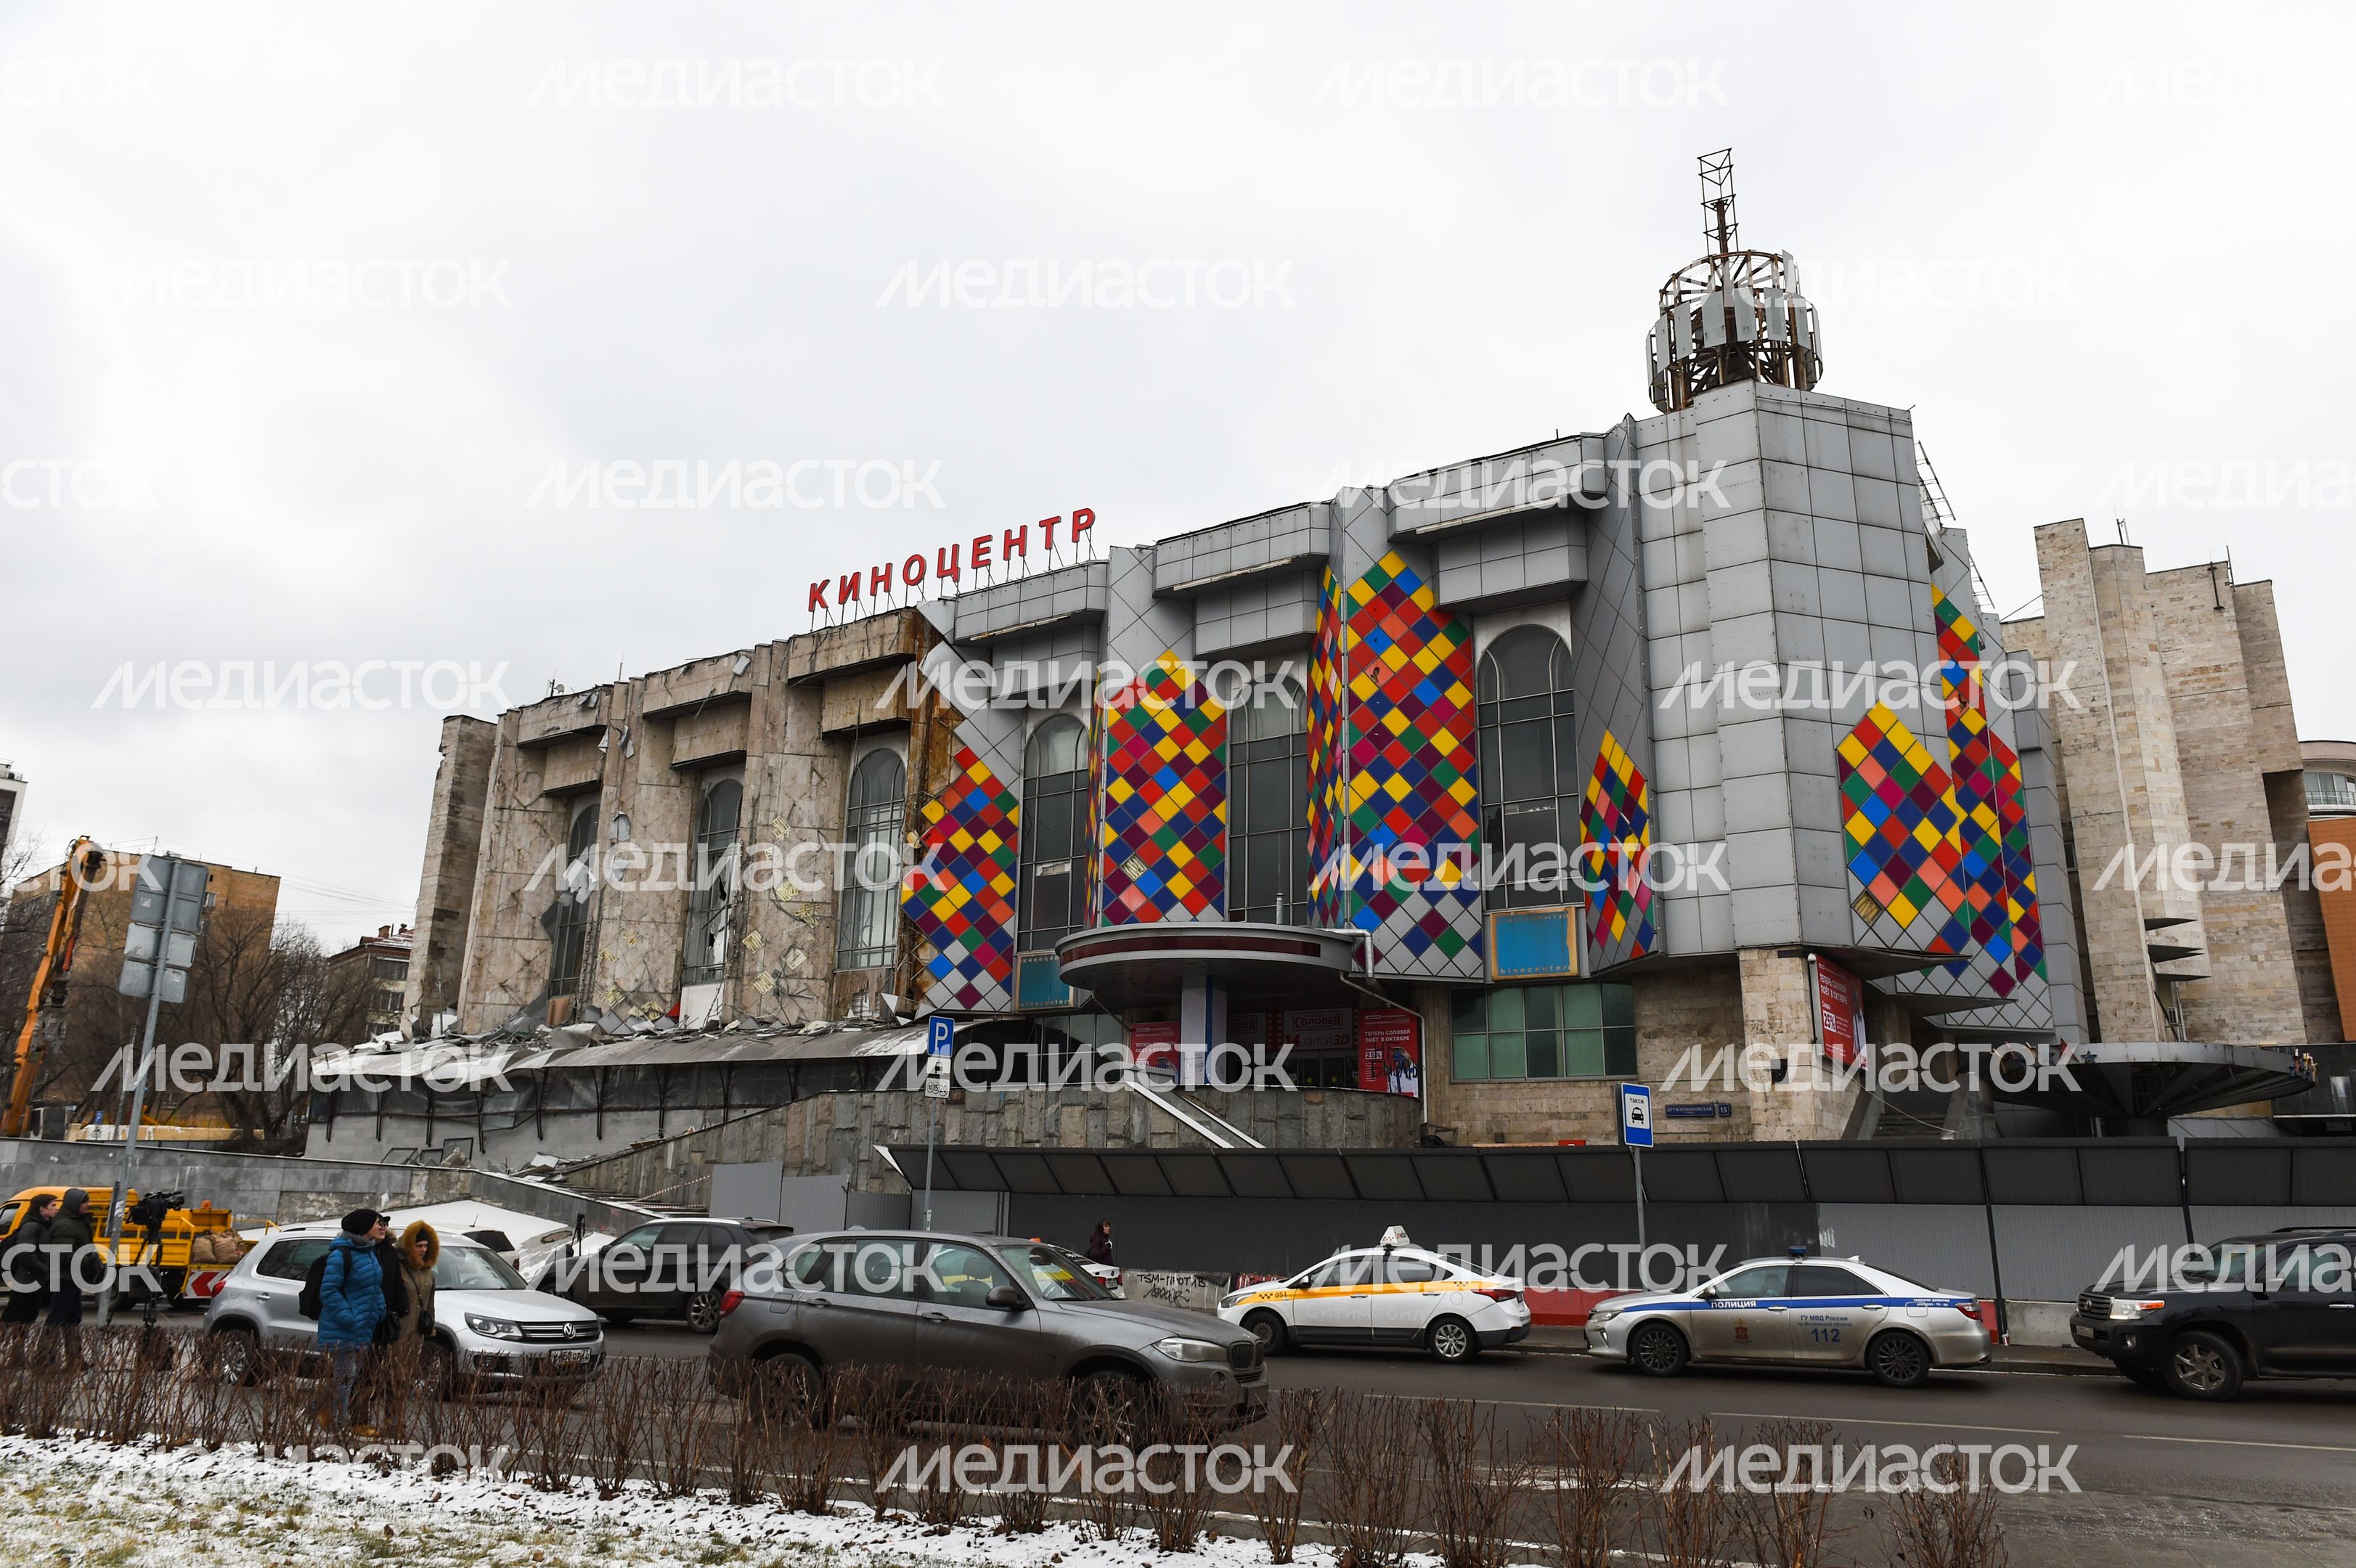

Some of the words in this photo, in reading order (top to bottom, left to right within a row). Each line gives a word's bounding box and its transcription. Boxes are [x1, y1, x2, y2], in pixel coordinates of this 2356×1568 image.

[808, 508, 1096, 612] КИНОЦЕНТР
[1823, 1012, 1836, 1030] 25%
[1711, 1300, 1757, 1309] ПОЛИЦИЯ
[1811, 1328, 1841, 1342] 112
